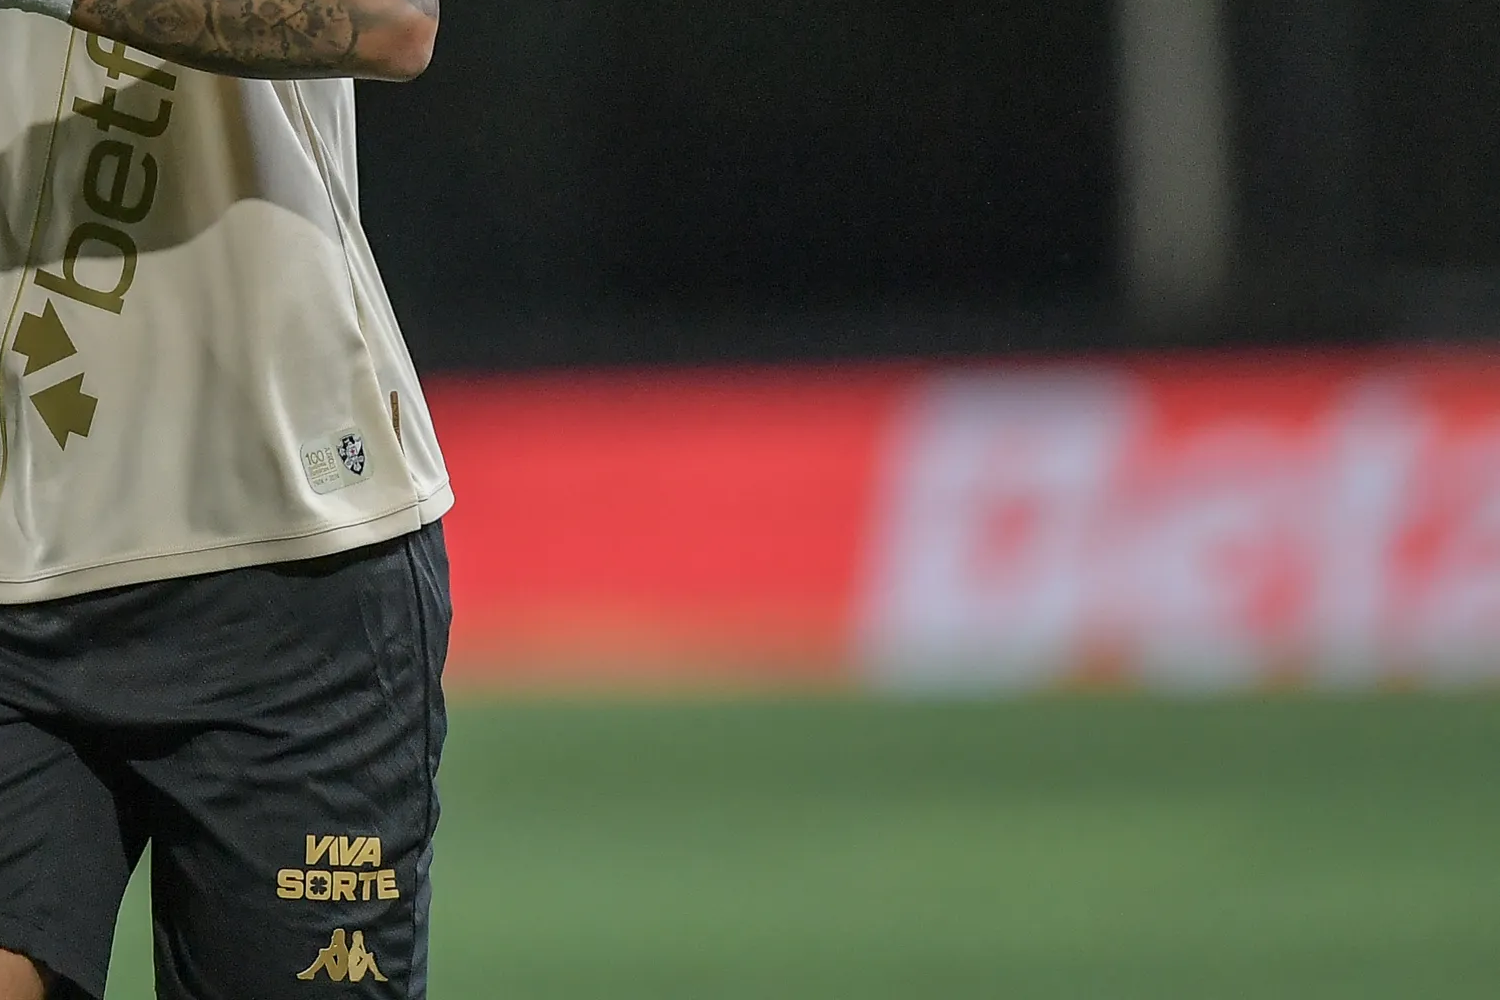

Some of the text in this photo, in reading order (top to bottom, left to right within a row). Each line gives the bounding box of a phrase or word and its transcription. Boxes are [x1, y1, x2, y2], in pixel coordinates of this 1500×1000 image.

[305, 449, 325, 466] 100
[305, 834, 381, 867] VIVA
[276, 868, 400, 901] SORTE
